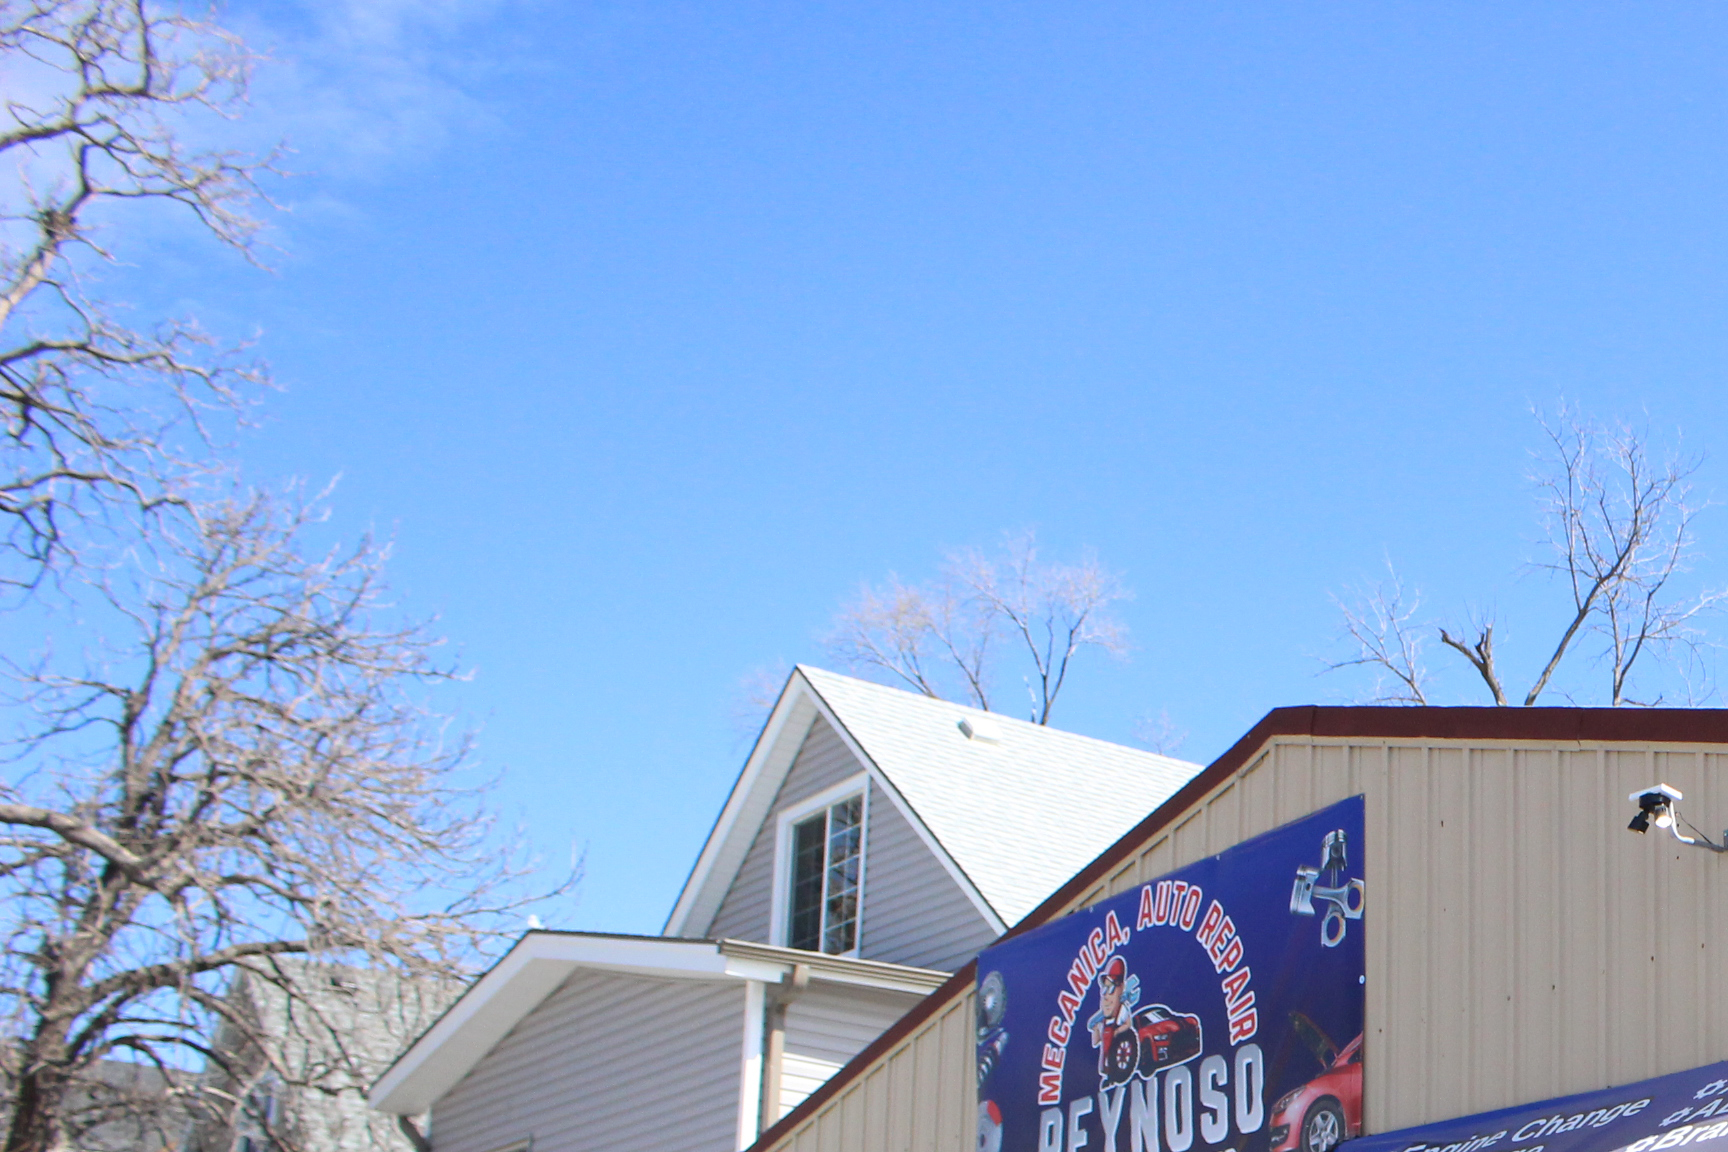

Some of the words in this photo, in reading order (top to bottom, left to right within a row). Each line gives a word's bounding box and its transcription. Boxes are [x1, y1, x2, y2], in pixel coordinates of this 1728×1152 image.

[1038, 911, 1131, 1105] MECANICA,
[1136, 880, 1202, 932] AUTO
[1197, 900, 1259, 1046] REPAIR
[1511, 1098, 1651, 1143] Change
